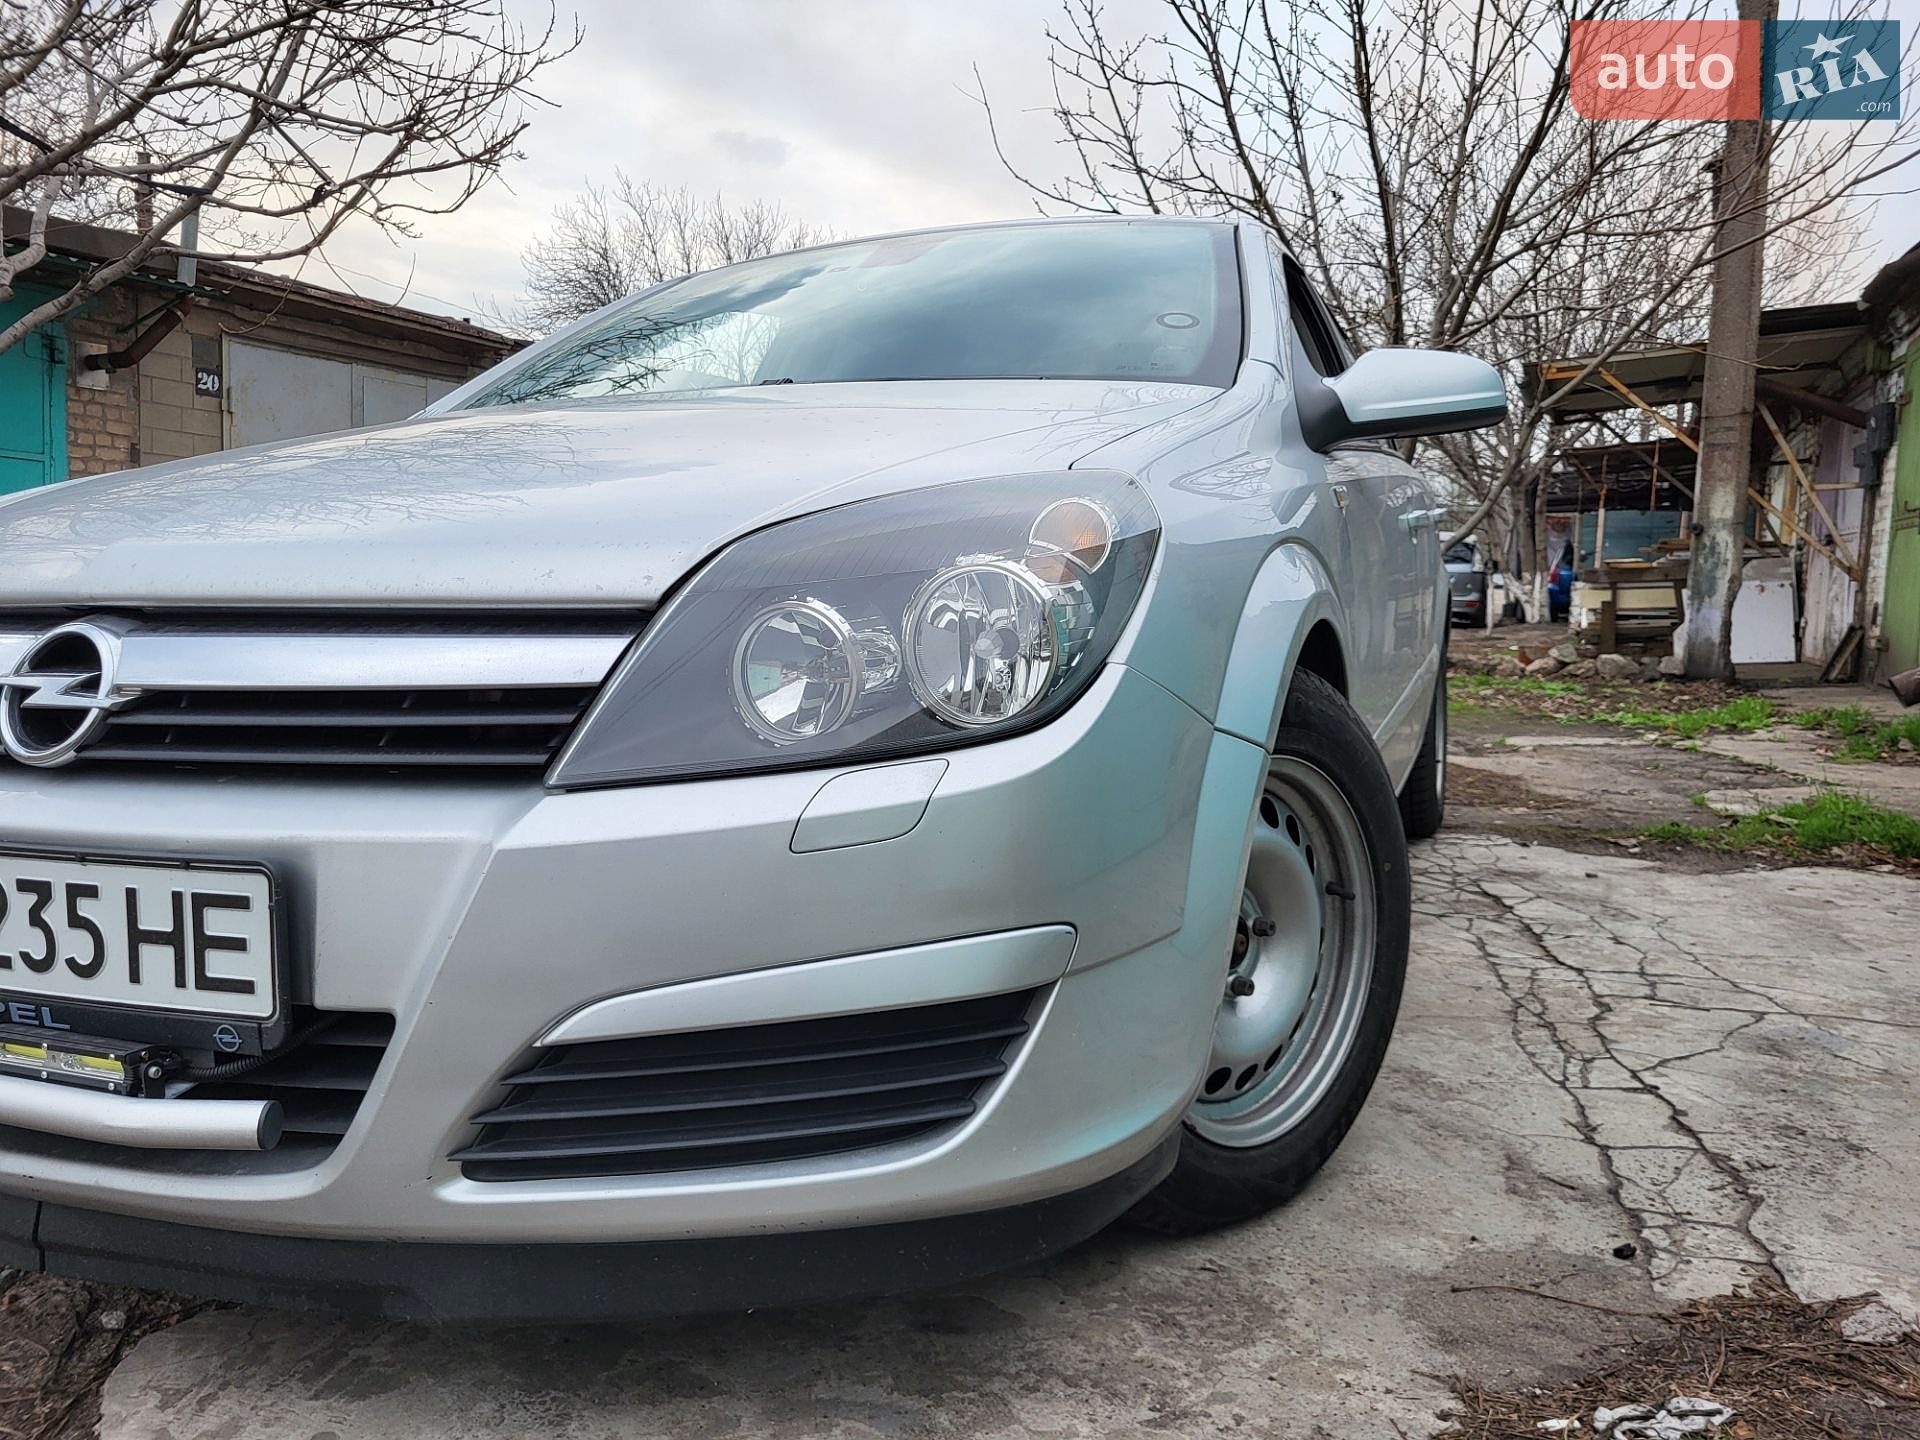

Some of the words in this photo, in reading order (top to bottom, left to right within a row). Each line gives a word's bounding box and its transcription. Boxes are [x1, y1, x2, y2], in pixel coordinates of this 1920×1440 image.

[197, 371, 220, 392] 20
[0, 877, 107, 979] 35
[124, 886, 256, 995] HE
[0, 1001, 71, 1031] EL
